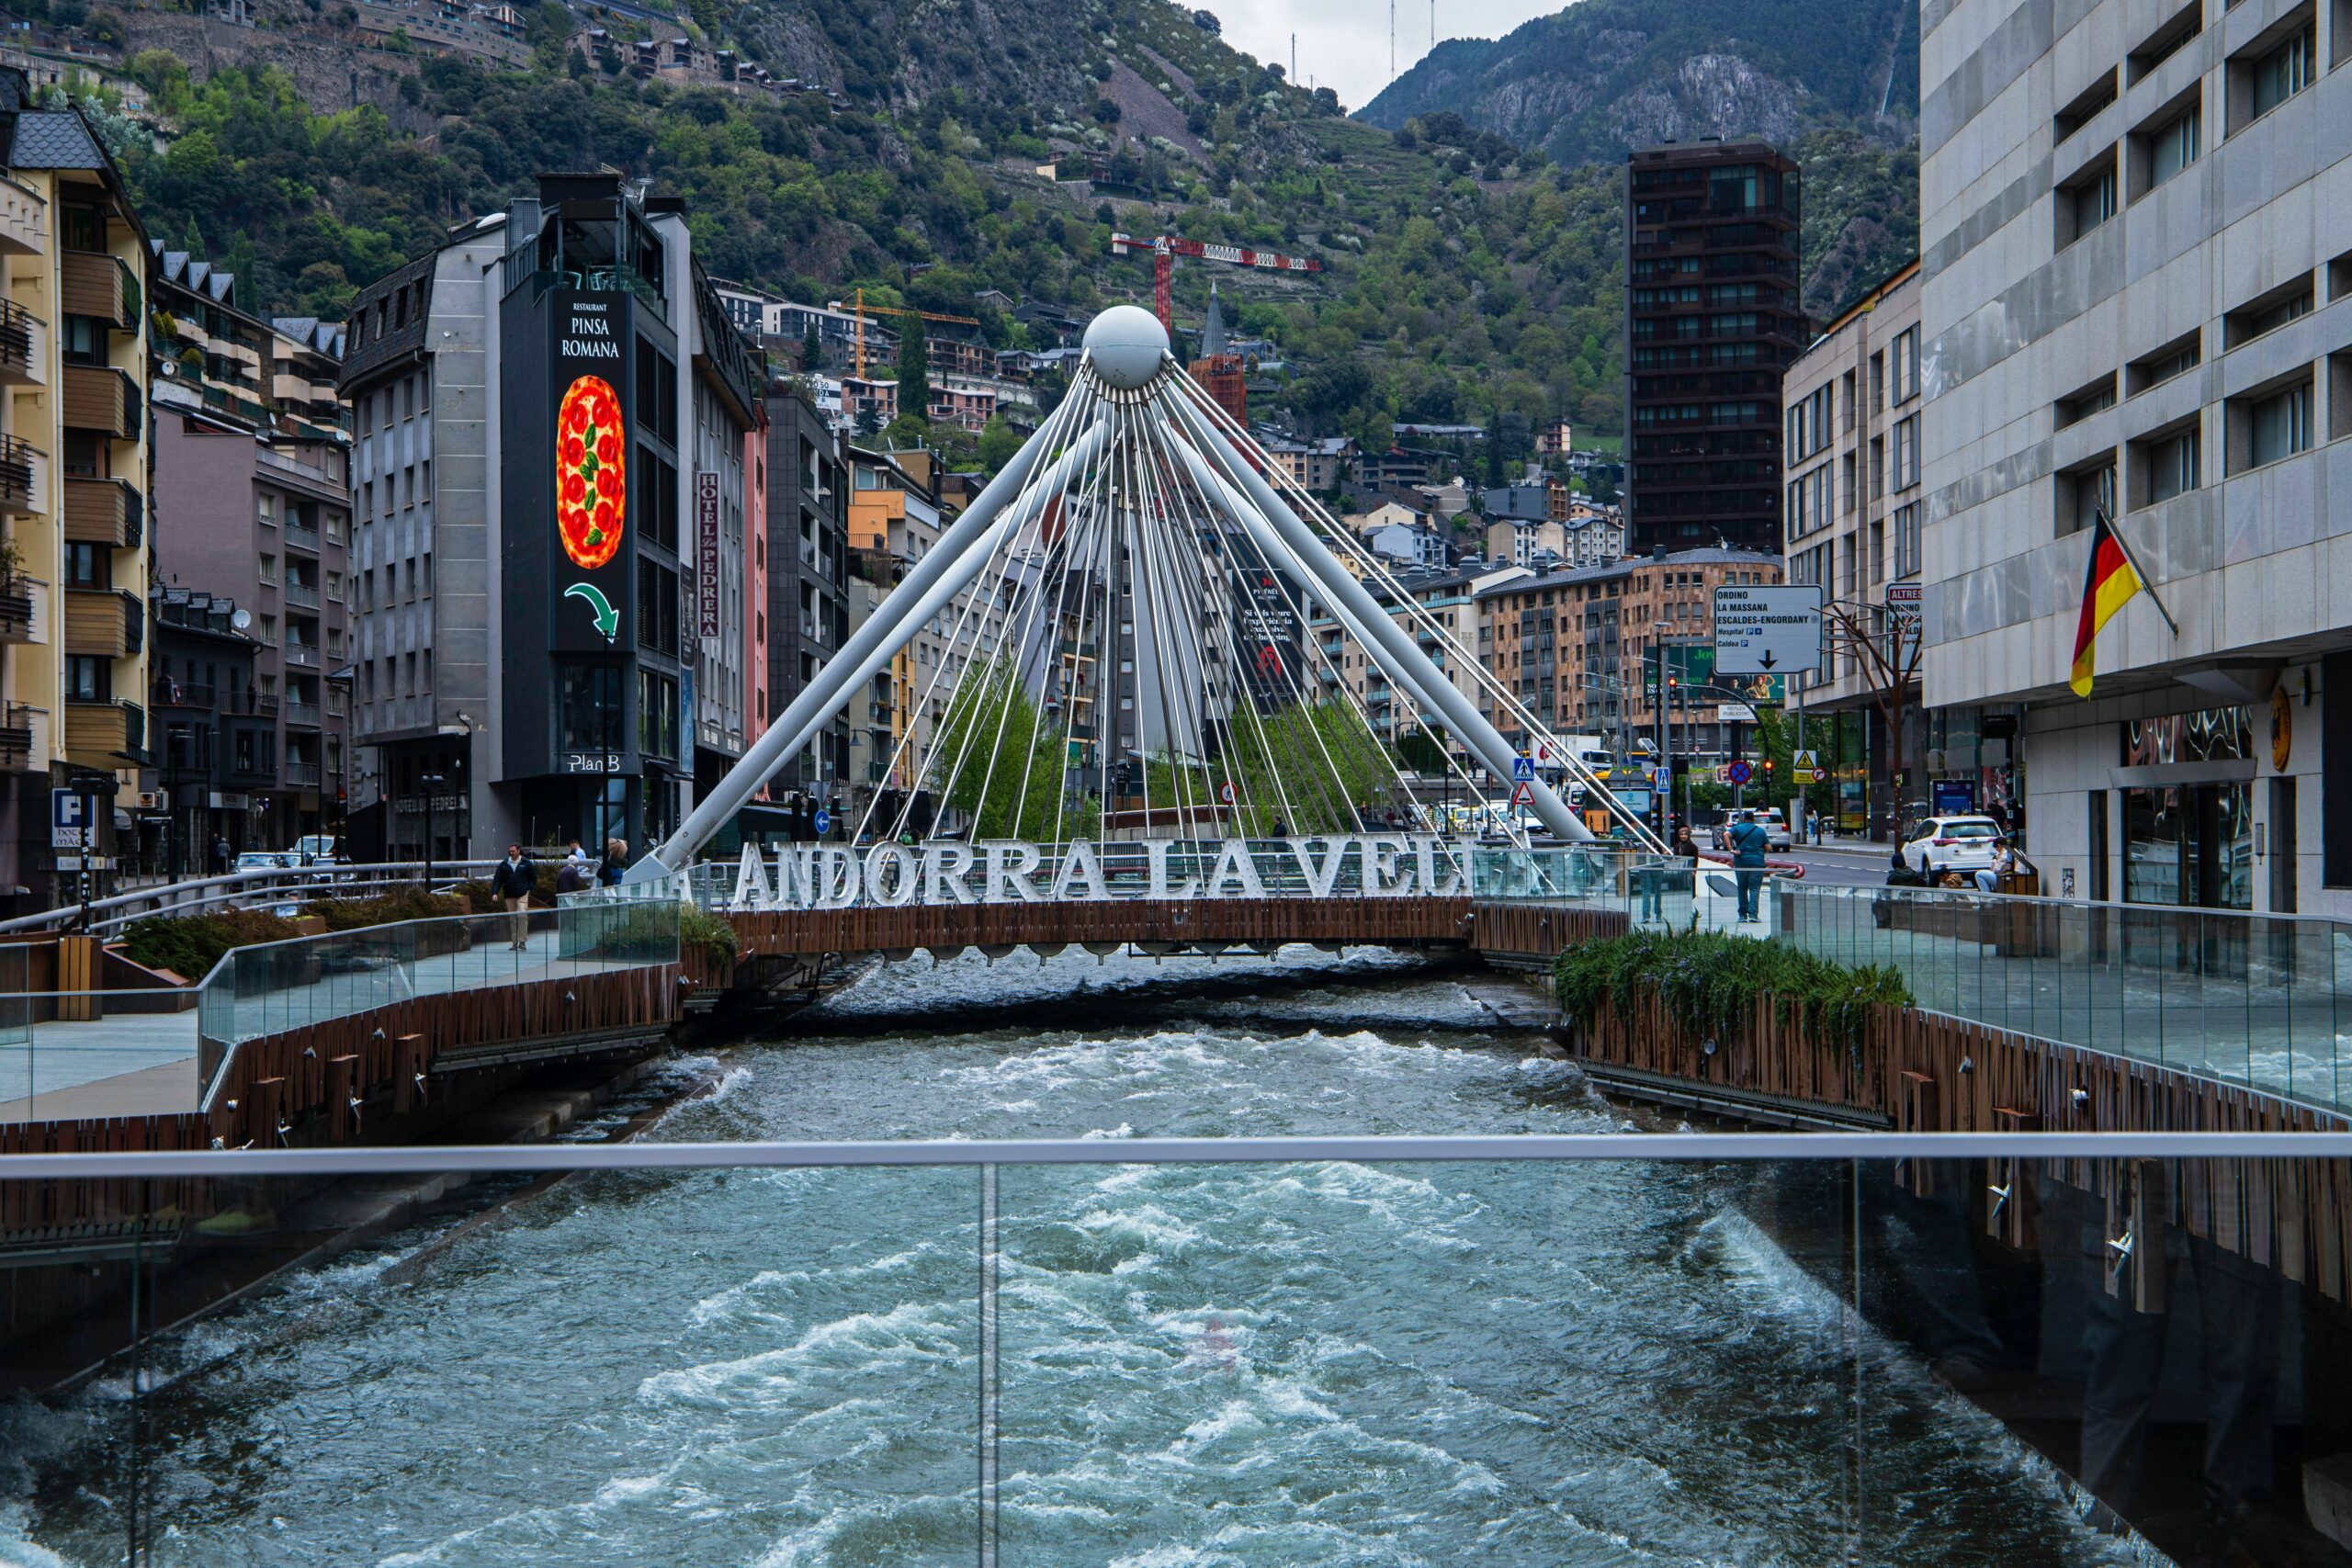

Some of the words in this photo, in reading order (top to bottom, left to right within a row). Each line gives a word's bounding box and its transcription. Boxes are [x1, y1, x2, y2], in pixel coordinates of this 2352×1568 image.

[572, 302, 607, 311] RESTAURANT
[571, 317, 610, 335] PINSA
[562, 339, 619, 358] ROMANA
[701, 474, 717, 536] HOTEL
[701, 549, 717, 636] PEDRERA
[1717, 591, 1748, 600] ORDINO
[1717, 604, 1727, 612] LA
[1729, 604, 1769, 612] MASSANA
[1717, 615, 1809, 625] ESCALDES-ENGORDANY
[1717, 628, 1745, 637] Hospital
[567, 754, 604, 772] Plan
[607, 755, 620, 772] B
[732, 838, 1114, 910] ANDORRA
[1142, 836, 1270, 899] LA
